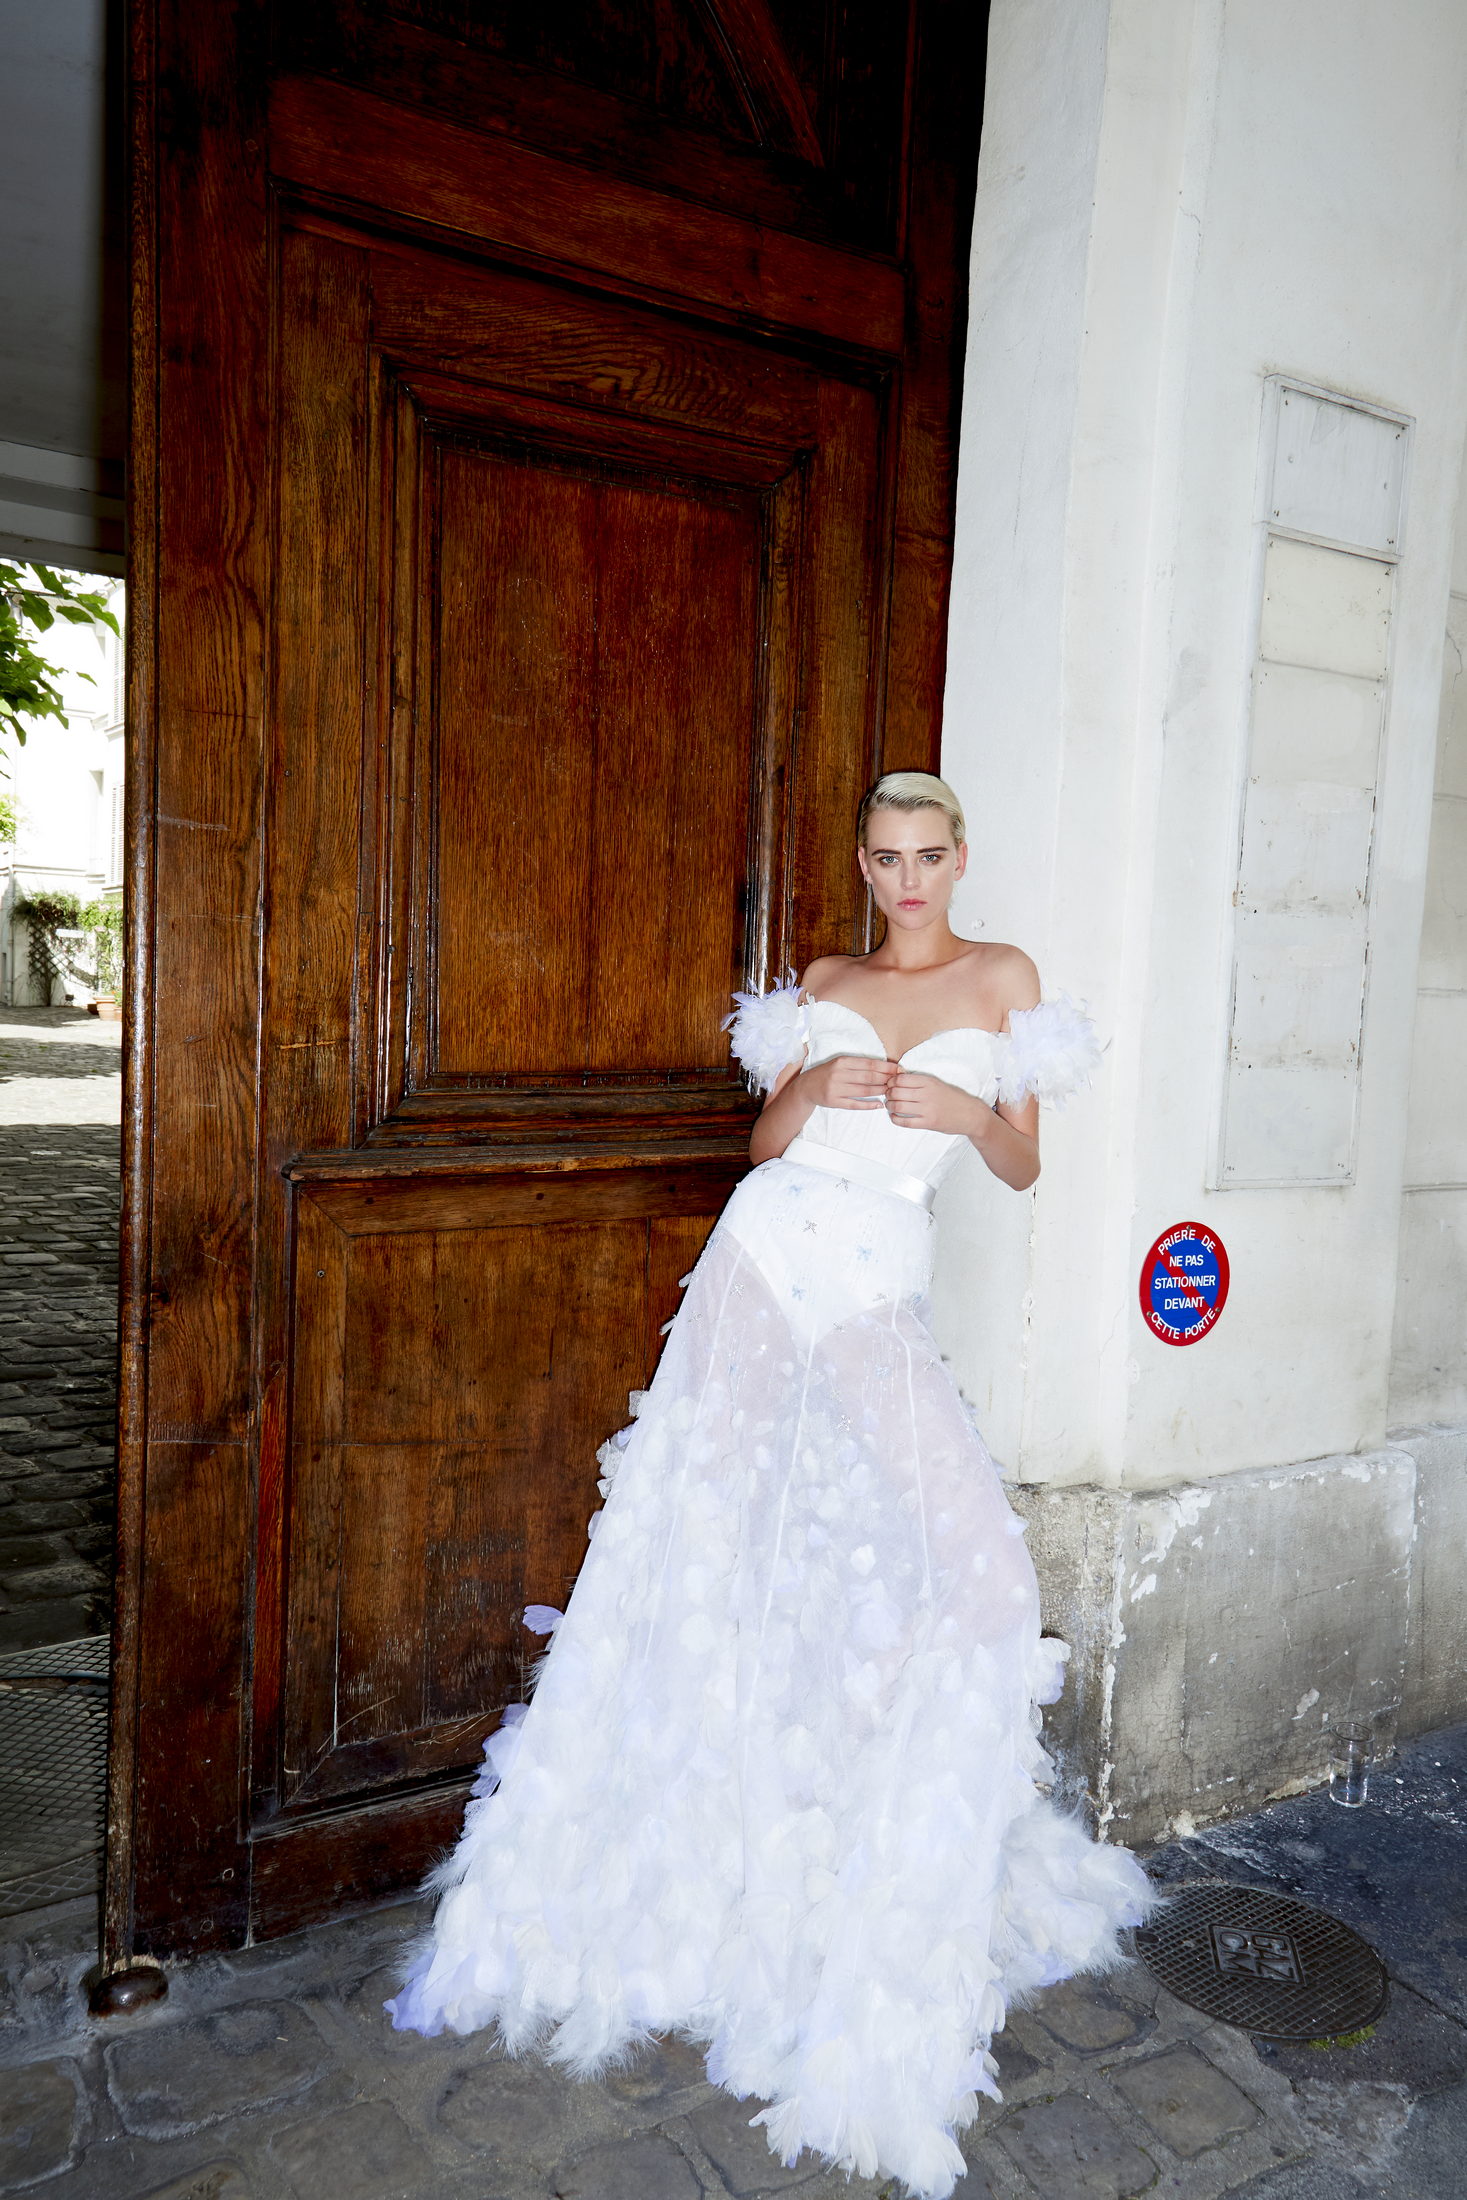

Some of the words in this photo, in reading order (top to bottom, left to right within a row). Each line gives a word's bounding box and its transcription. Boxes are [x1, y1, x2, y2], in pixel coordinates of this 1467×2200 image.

[1157, 1229, 1196, 1255] PRIERE
[1201, 1235, 1216, 1253] DE
[1169, 1255, 1183, 1267] NE
[1185, 1254, 1204, 1266] PAS
[1154, 1275, 1216, 1289] STATIONNER
[1164, 1296, 1205, 1310] DEVANT
[1151, 1311, 1180, 1339] CETTE
[1185, 1308, 1216, 1339] PORTE
[1251, 1935, 1295, 1979] GAZ
